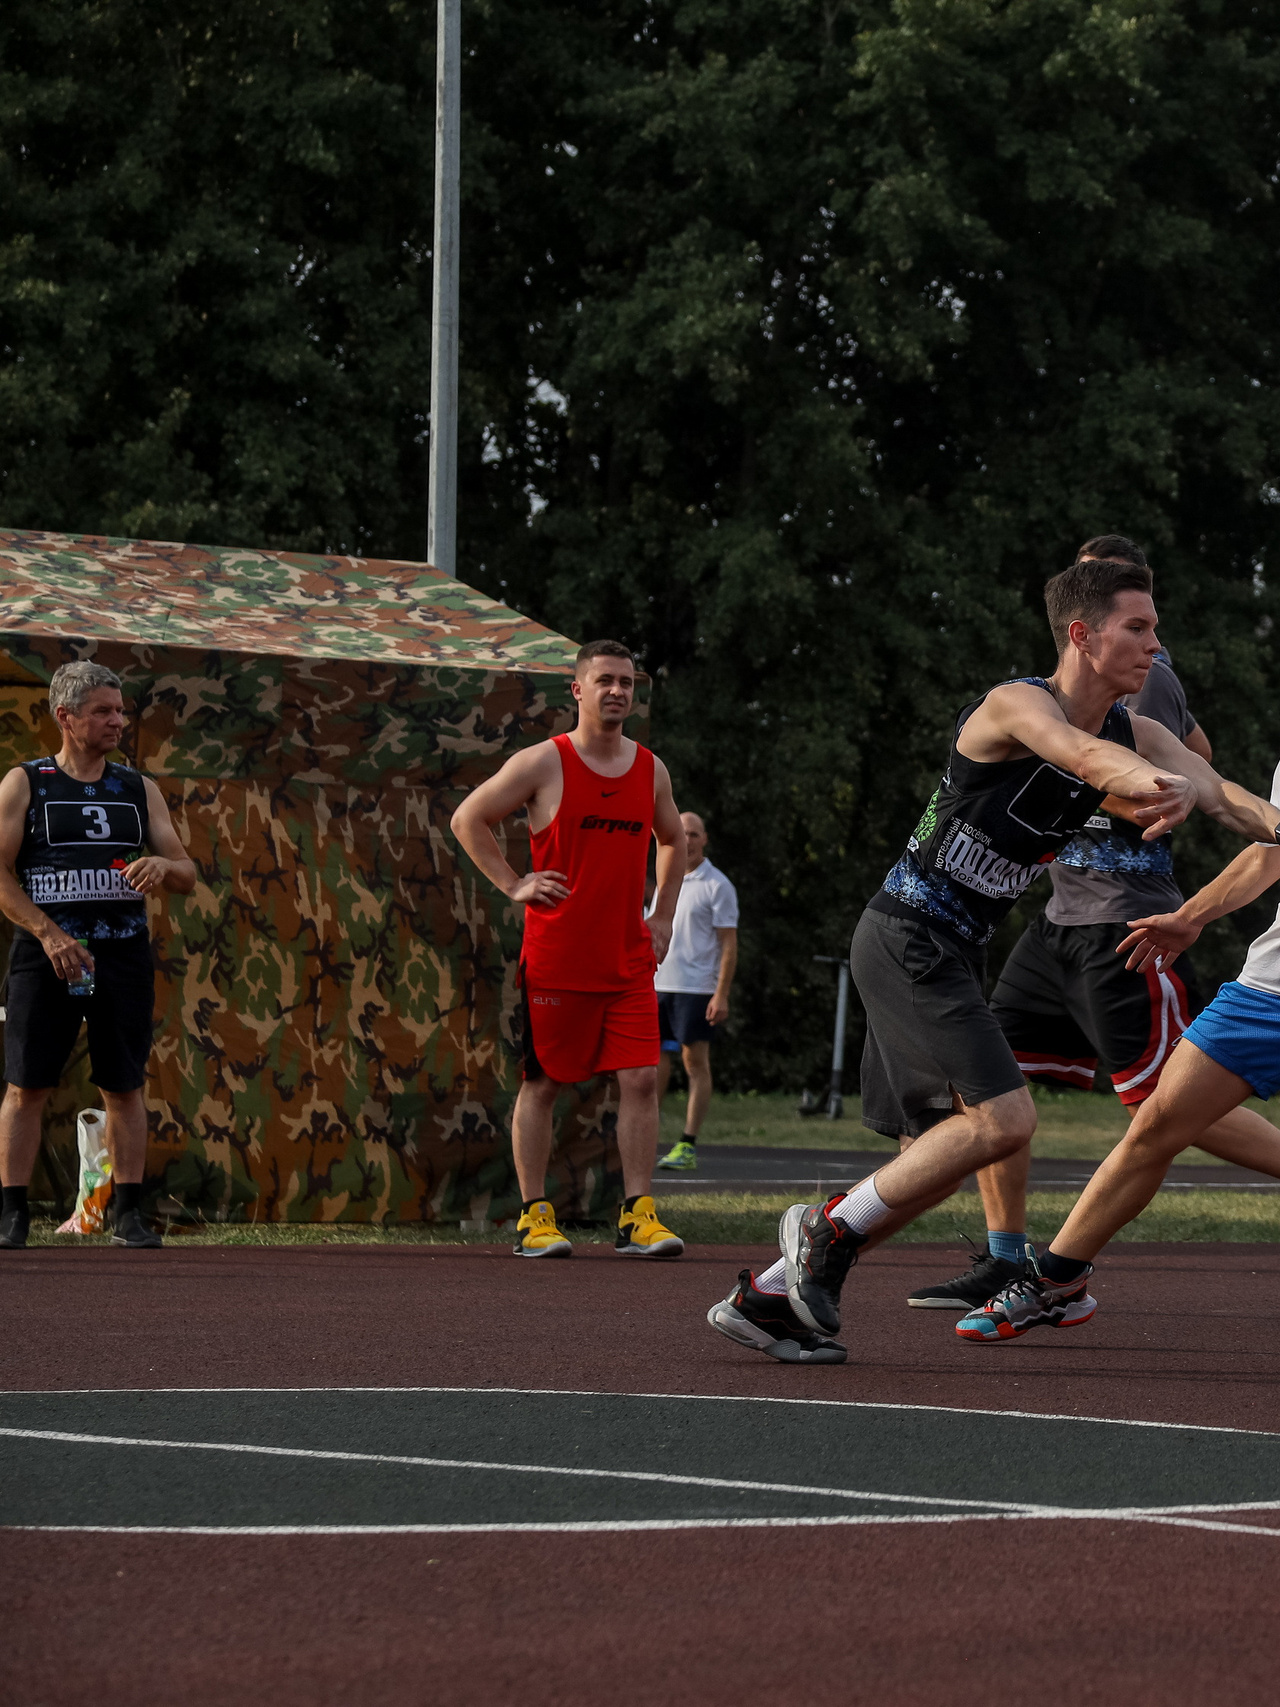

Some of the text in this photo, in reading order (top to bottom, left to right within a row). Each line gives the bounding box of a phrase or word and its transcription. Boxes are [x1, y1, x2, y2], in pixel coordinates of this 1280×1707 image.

[82, 805, 111, 839] 3
[934, 816, 962, 869] коттеджный
[35, 894, 58, 902] Моя
[60, 892, 120, 900] маленькая
